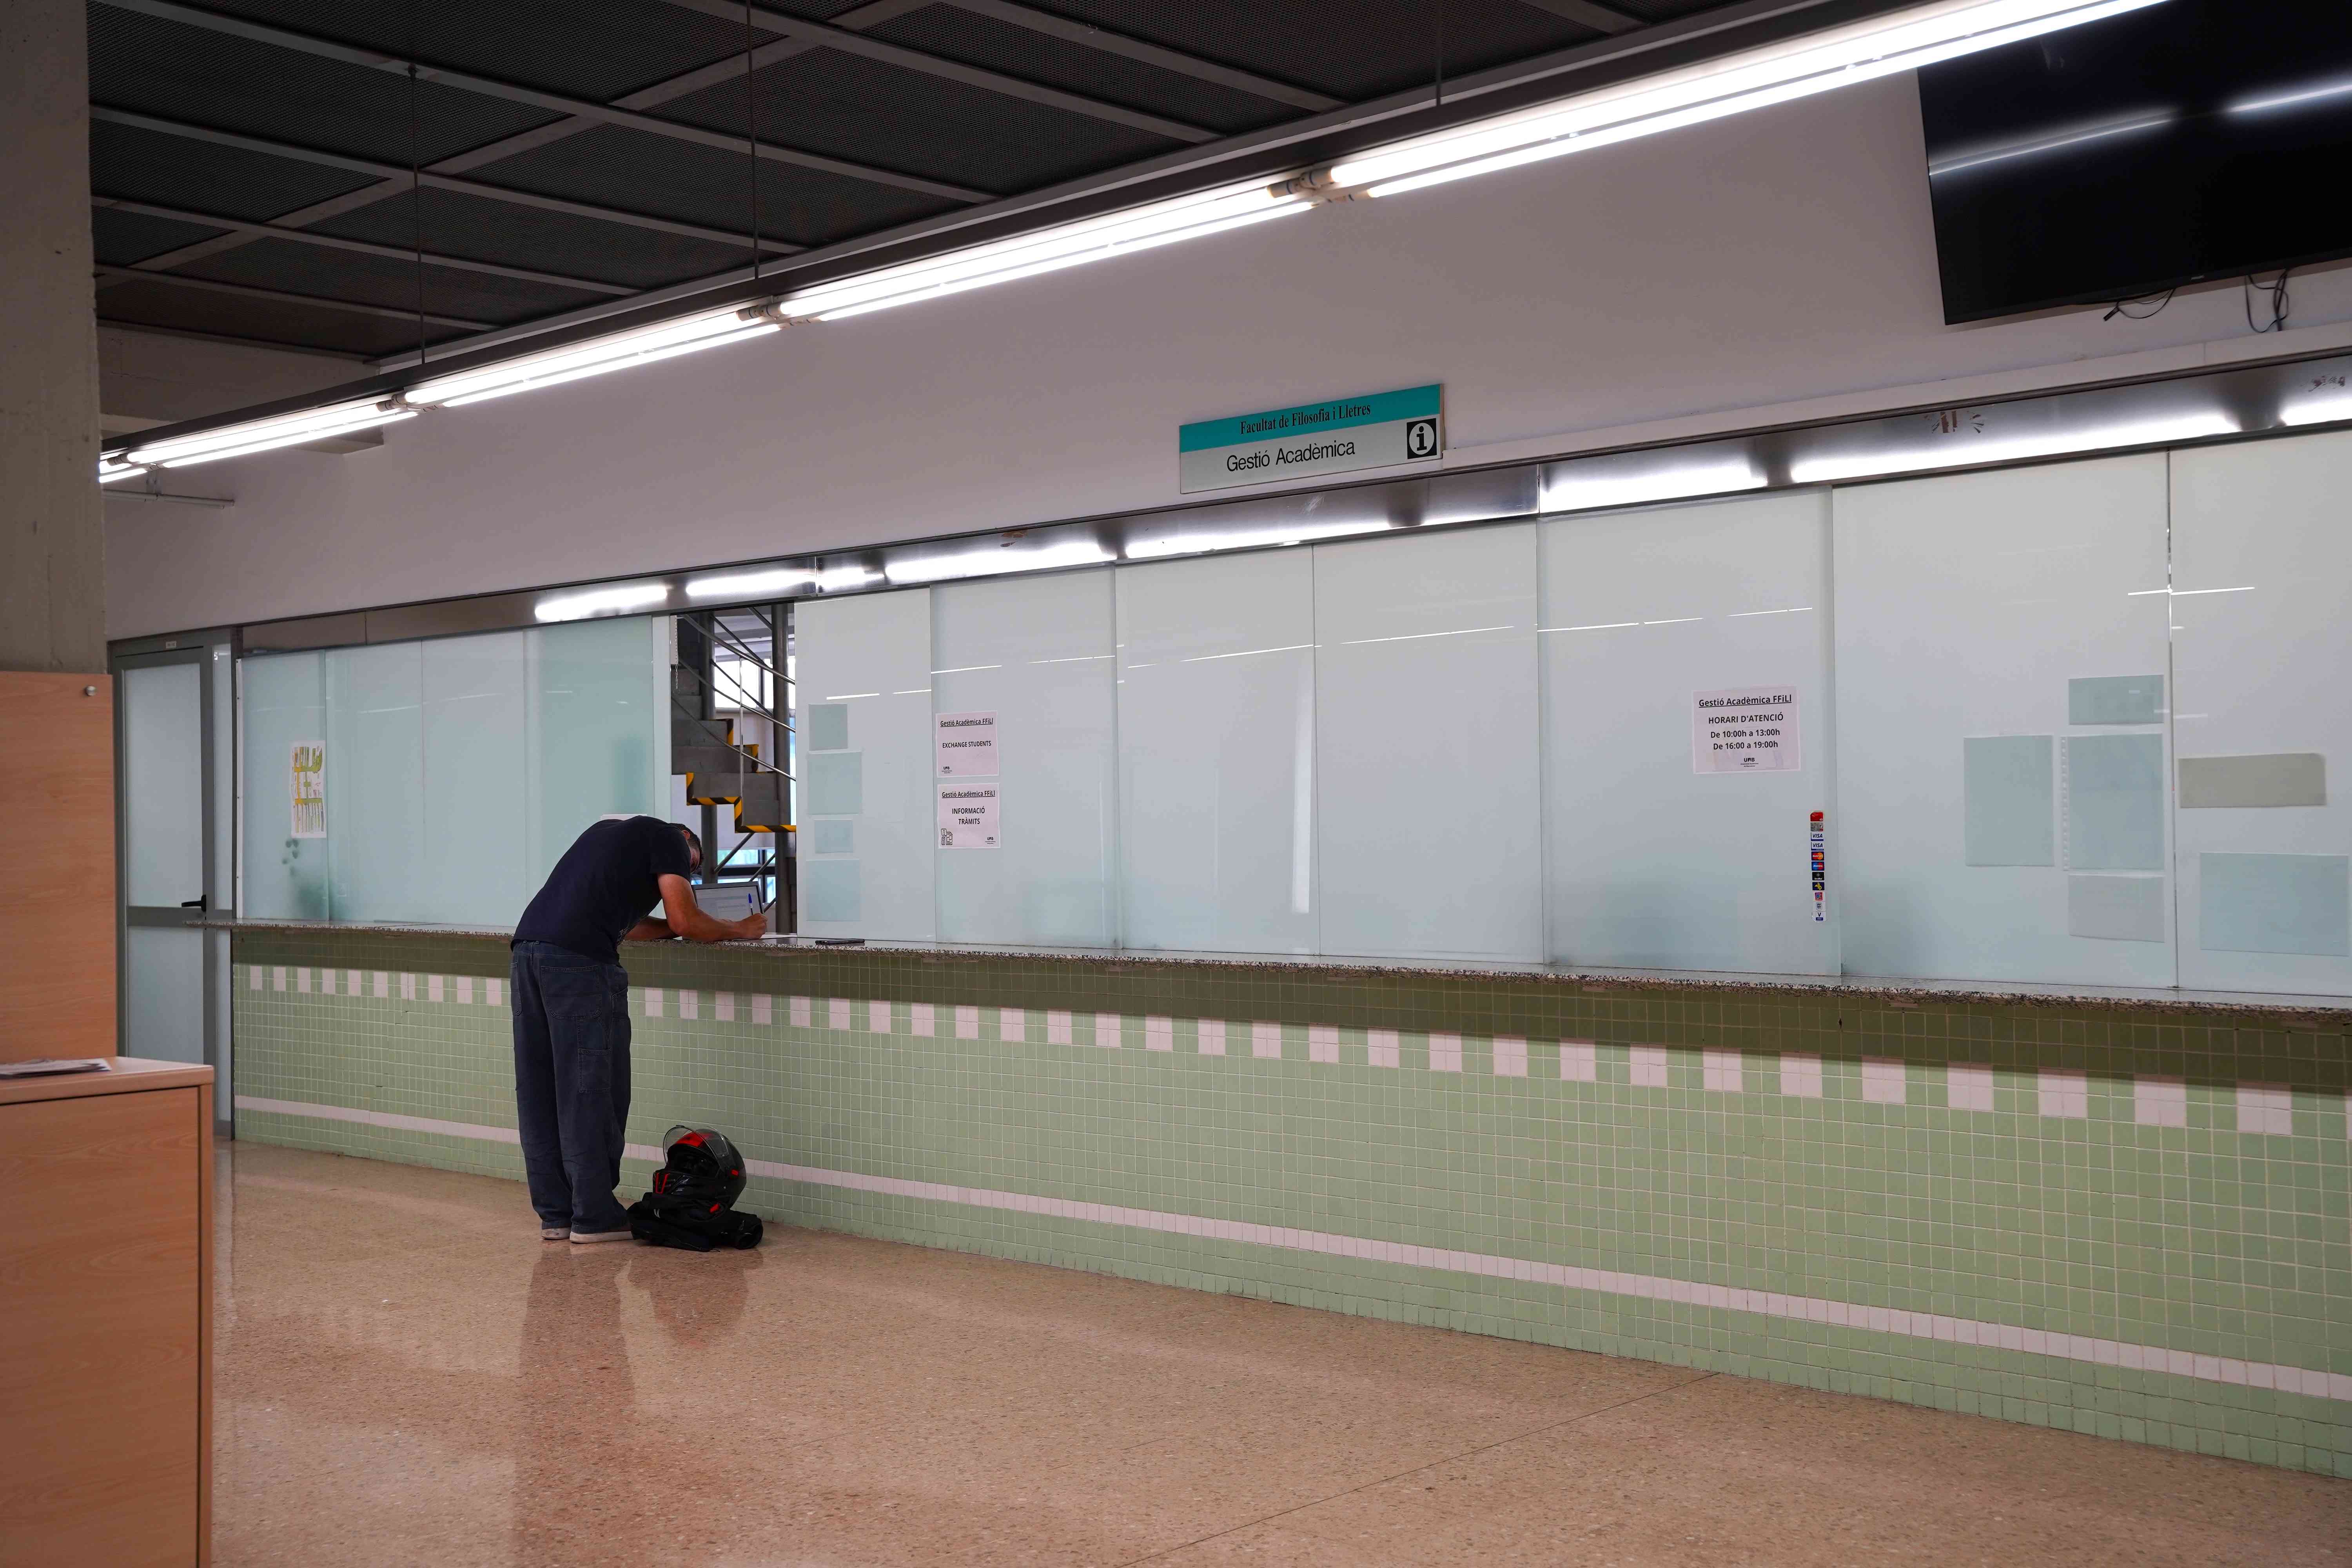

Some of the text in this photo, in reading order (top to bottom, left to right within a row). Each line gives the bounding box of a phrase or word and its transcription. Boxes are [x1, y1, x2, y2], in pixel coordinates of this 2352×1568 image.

[1240, 403, 1371, 435] Facultat de Filosofia i Lletres
[1227, 440, 1356, 472] Gestió Acadèmica
[1699, 698, 1724, 707] Gestió
[1726, 696, 1771, 706] Acadèmica
[1709, 711, 1783, 724] HORARI D'ATENCIÓ
[1722, 730, 1746, 738] 10:00h
[1756, 728, 1780, 737] 13:00h
[952, 806, 985, 814] INFORMACIÓ
